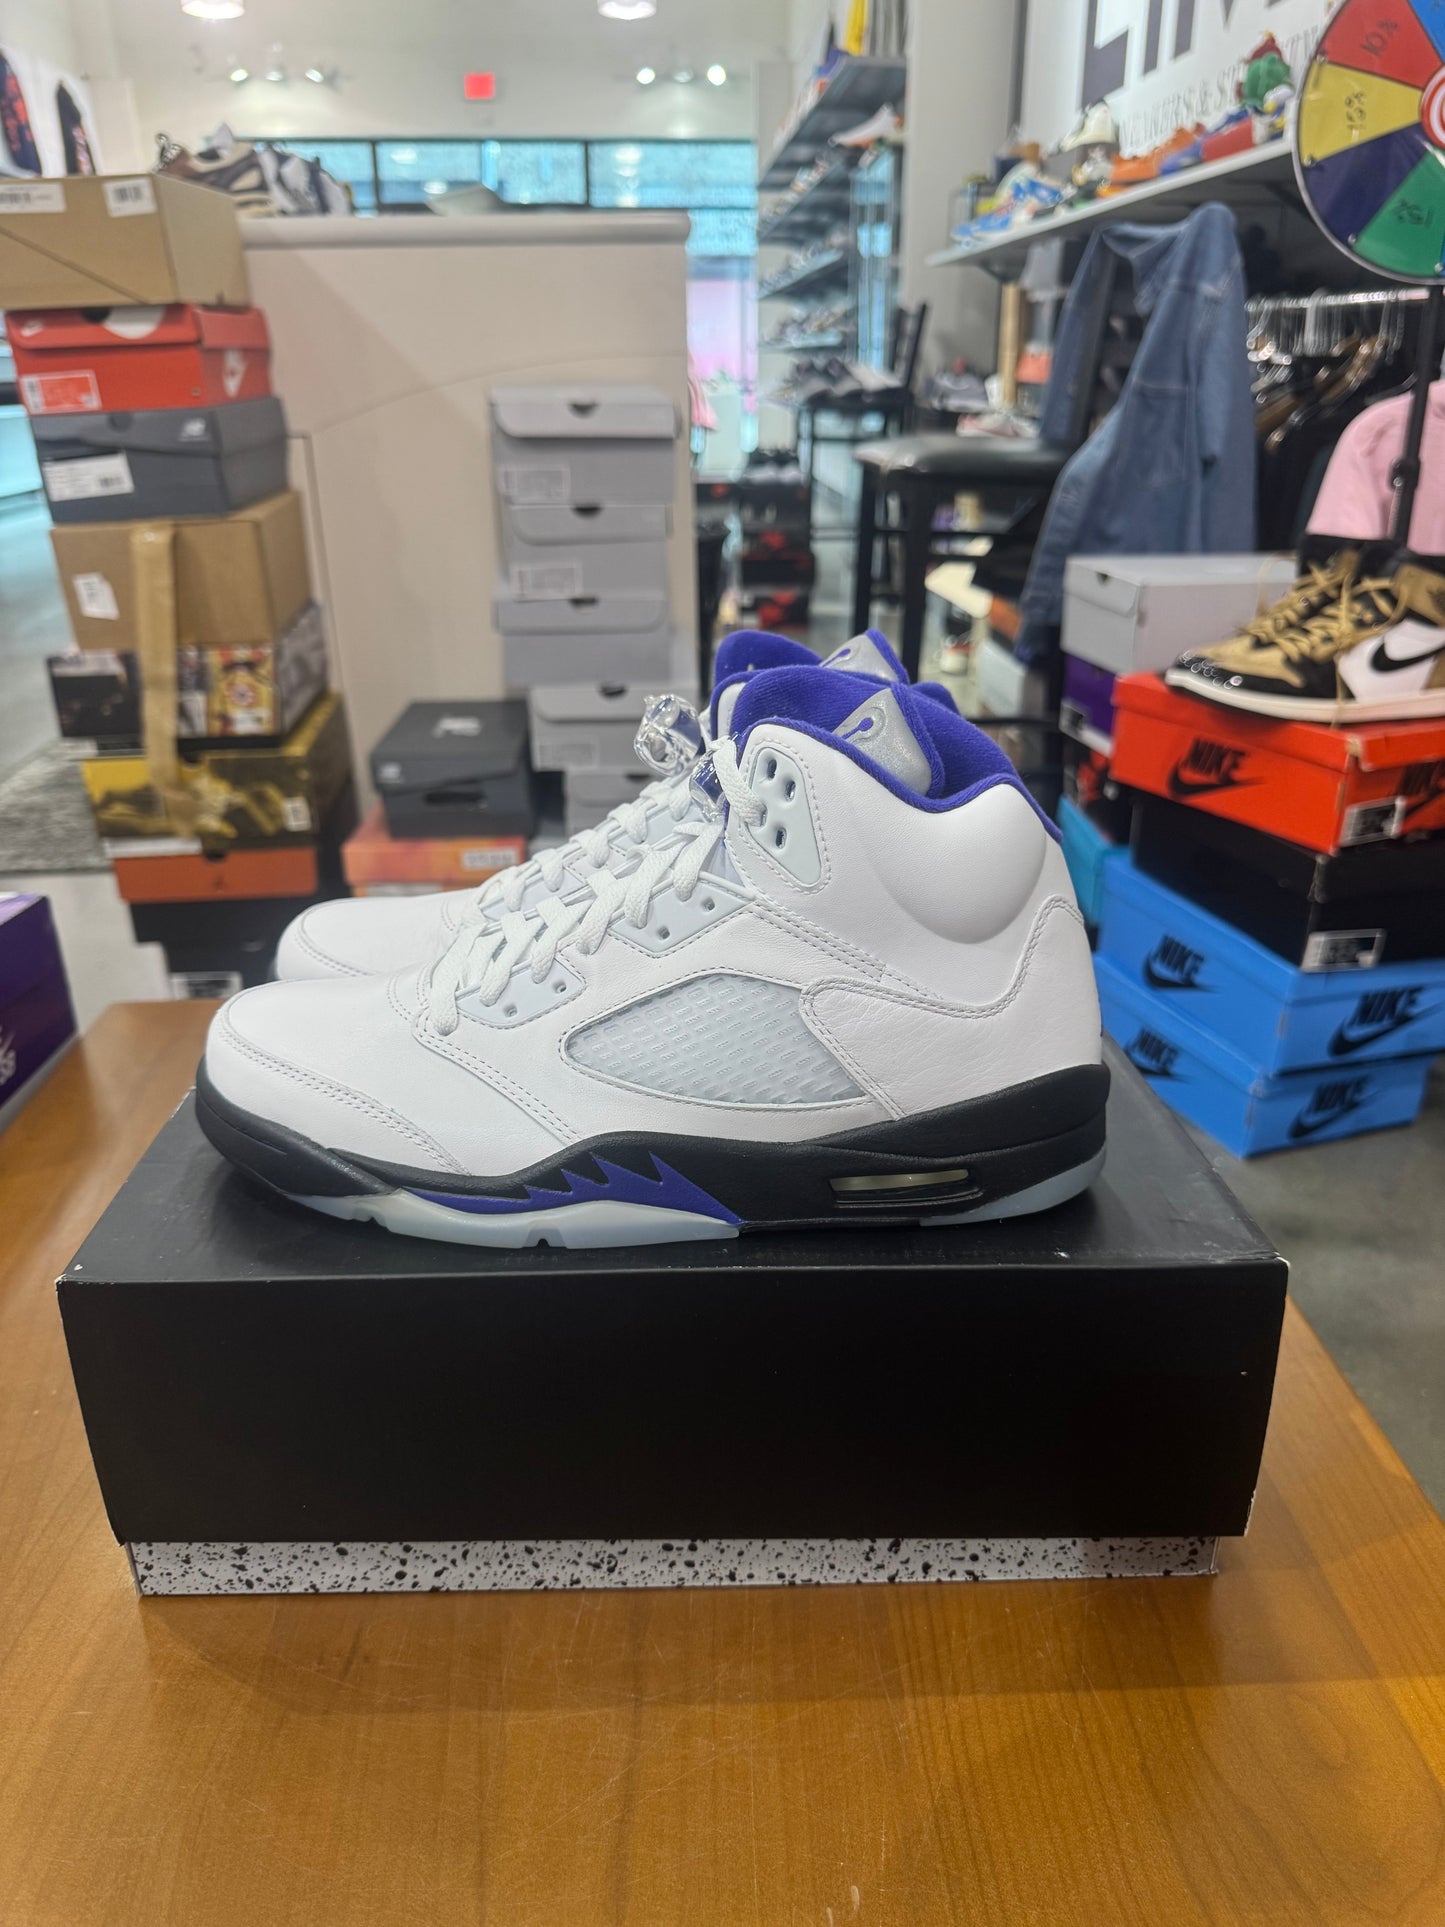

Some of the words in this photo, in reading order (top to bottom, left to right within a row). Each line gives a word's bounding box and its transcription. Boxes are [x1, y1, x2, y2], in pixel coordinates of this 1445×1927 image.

[1182, 737, 1249, 784] NIKE
[1156, 934, 1206, 982] NIKE
[1350, 986, 1425, 1026] NIKE
[1134, 1027, 1179, 1073] NIKE
[1308, 1076, 1370, 1113] NIKE
